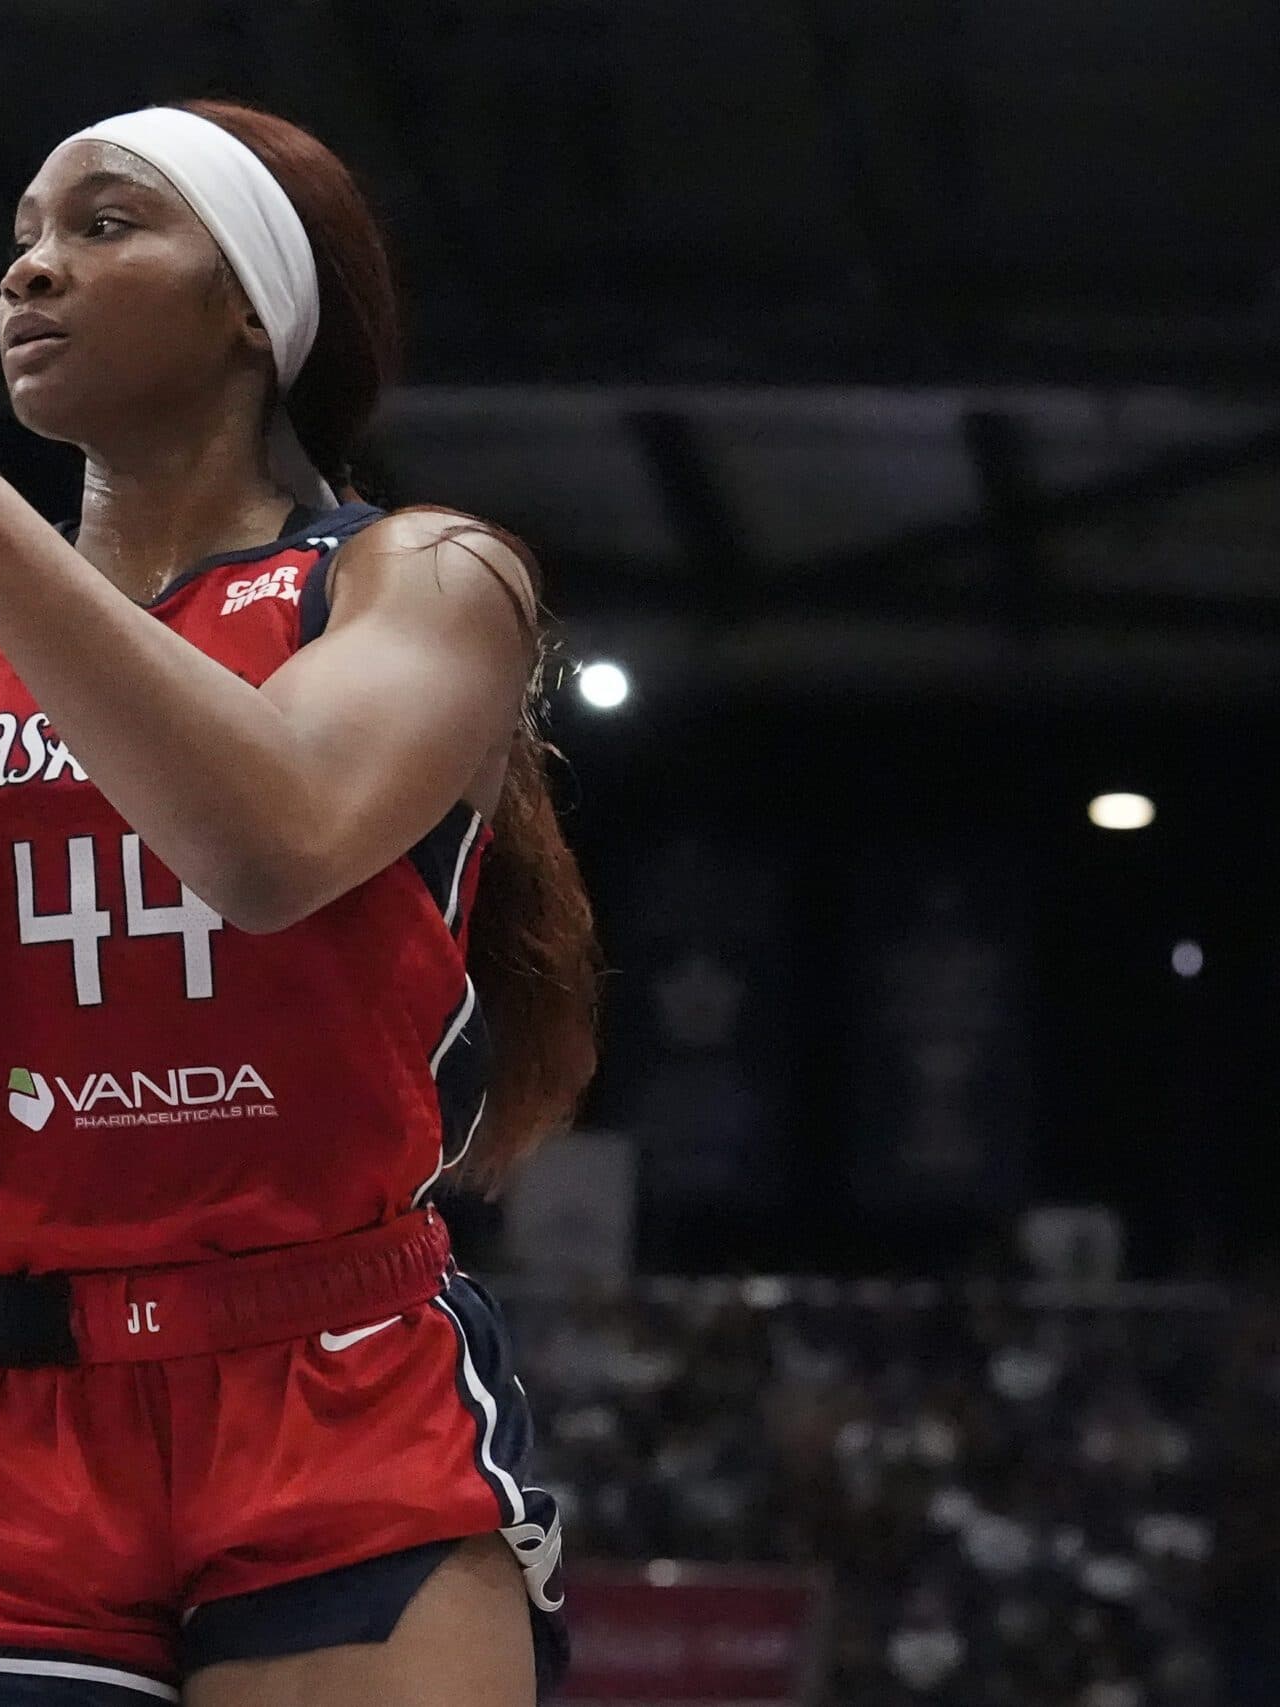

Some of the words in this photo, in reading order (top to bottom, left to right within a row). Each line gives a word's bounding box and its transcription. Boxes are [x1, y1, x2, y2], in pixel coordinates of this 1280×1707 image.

[226, 566, 299, 600] CAR
[14, 833, 223, 1006] 44
[55, 1064, 274, 1112] VANDA
[74, 1105, 242, 1129] PHARMACEUTICALS
